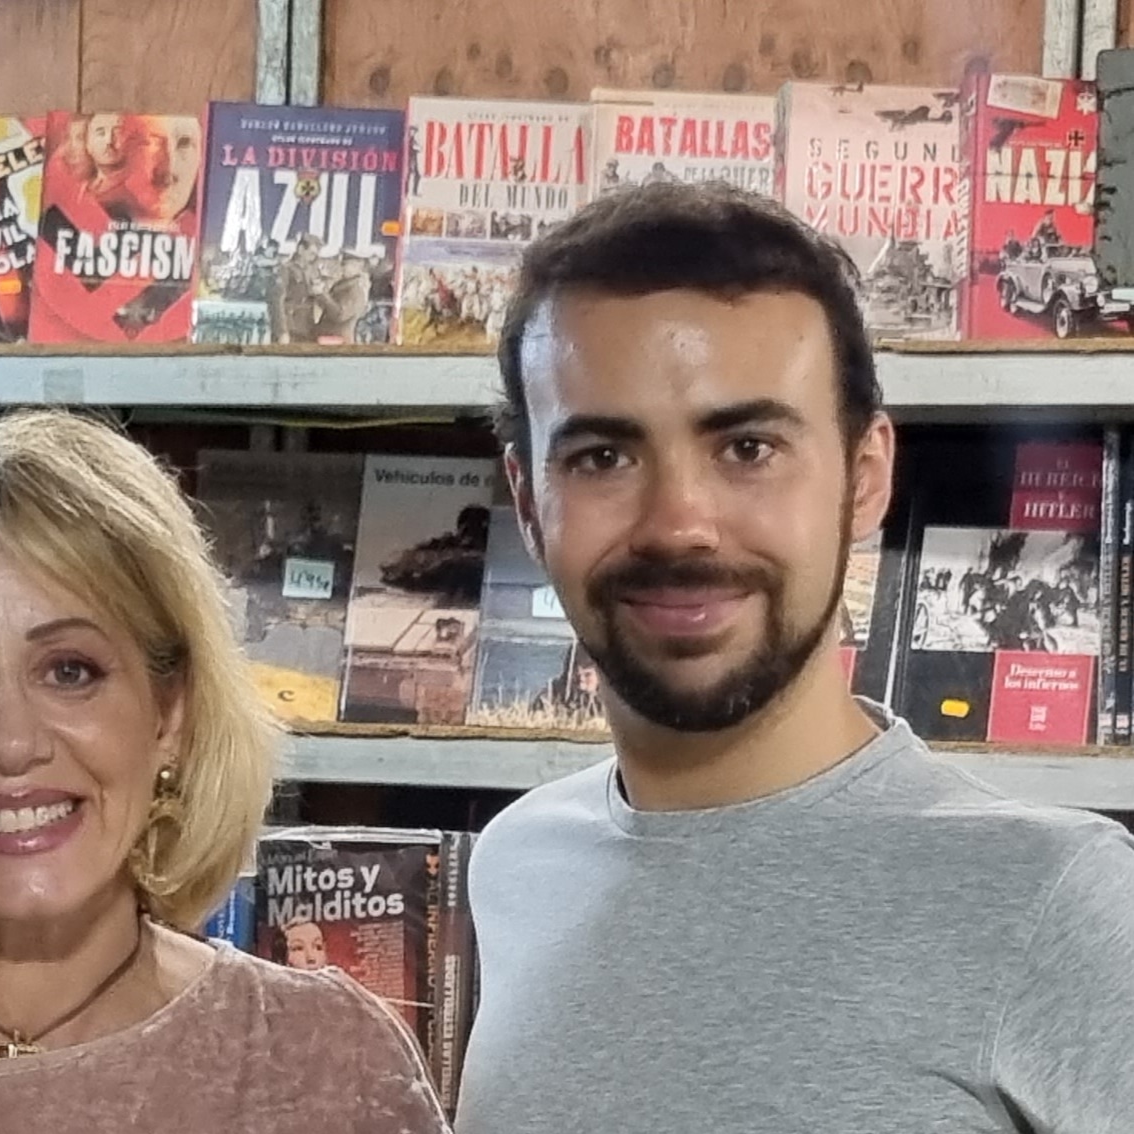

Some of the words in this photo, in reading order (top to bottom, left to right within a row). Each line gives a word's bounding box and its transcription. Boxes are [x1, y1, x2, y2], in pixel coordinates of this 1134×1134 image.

[615, 115, 772, 161] BATALLAS
[222, 144, 257, 166] LA
[268, 145, 397, 172] DIVISIÓN
[459, 183, 493, 209] DEL
[506, 184, 568, 209] MUNDO
[220, 167, 386, 259] AZUL
[1024, 502, 1095, 519] HITLER
[268, 864, 355, 896] Mitos
[360, 863, 380, 894] y
[267, 889, 405, 927] Malditos
